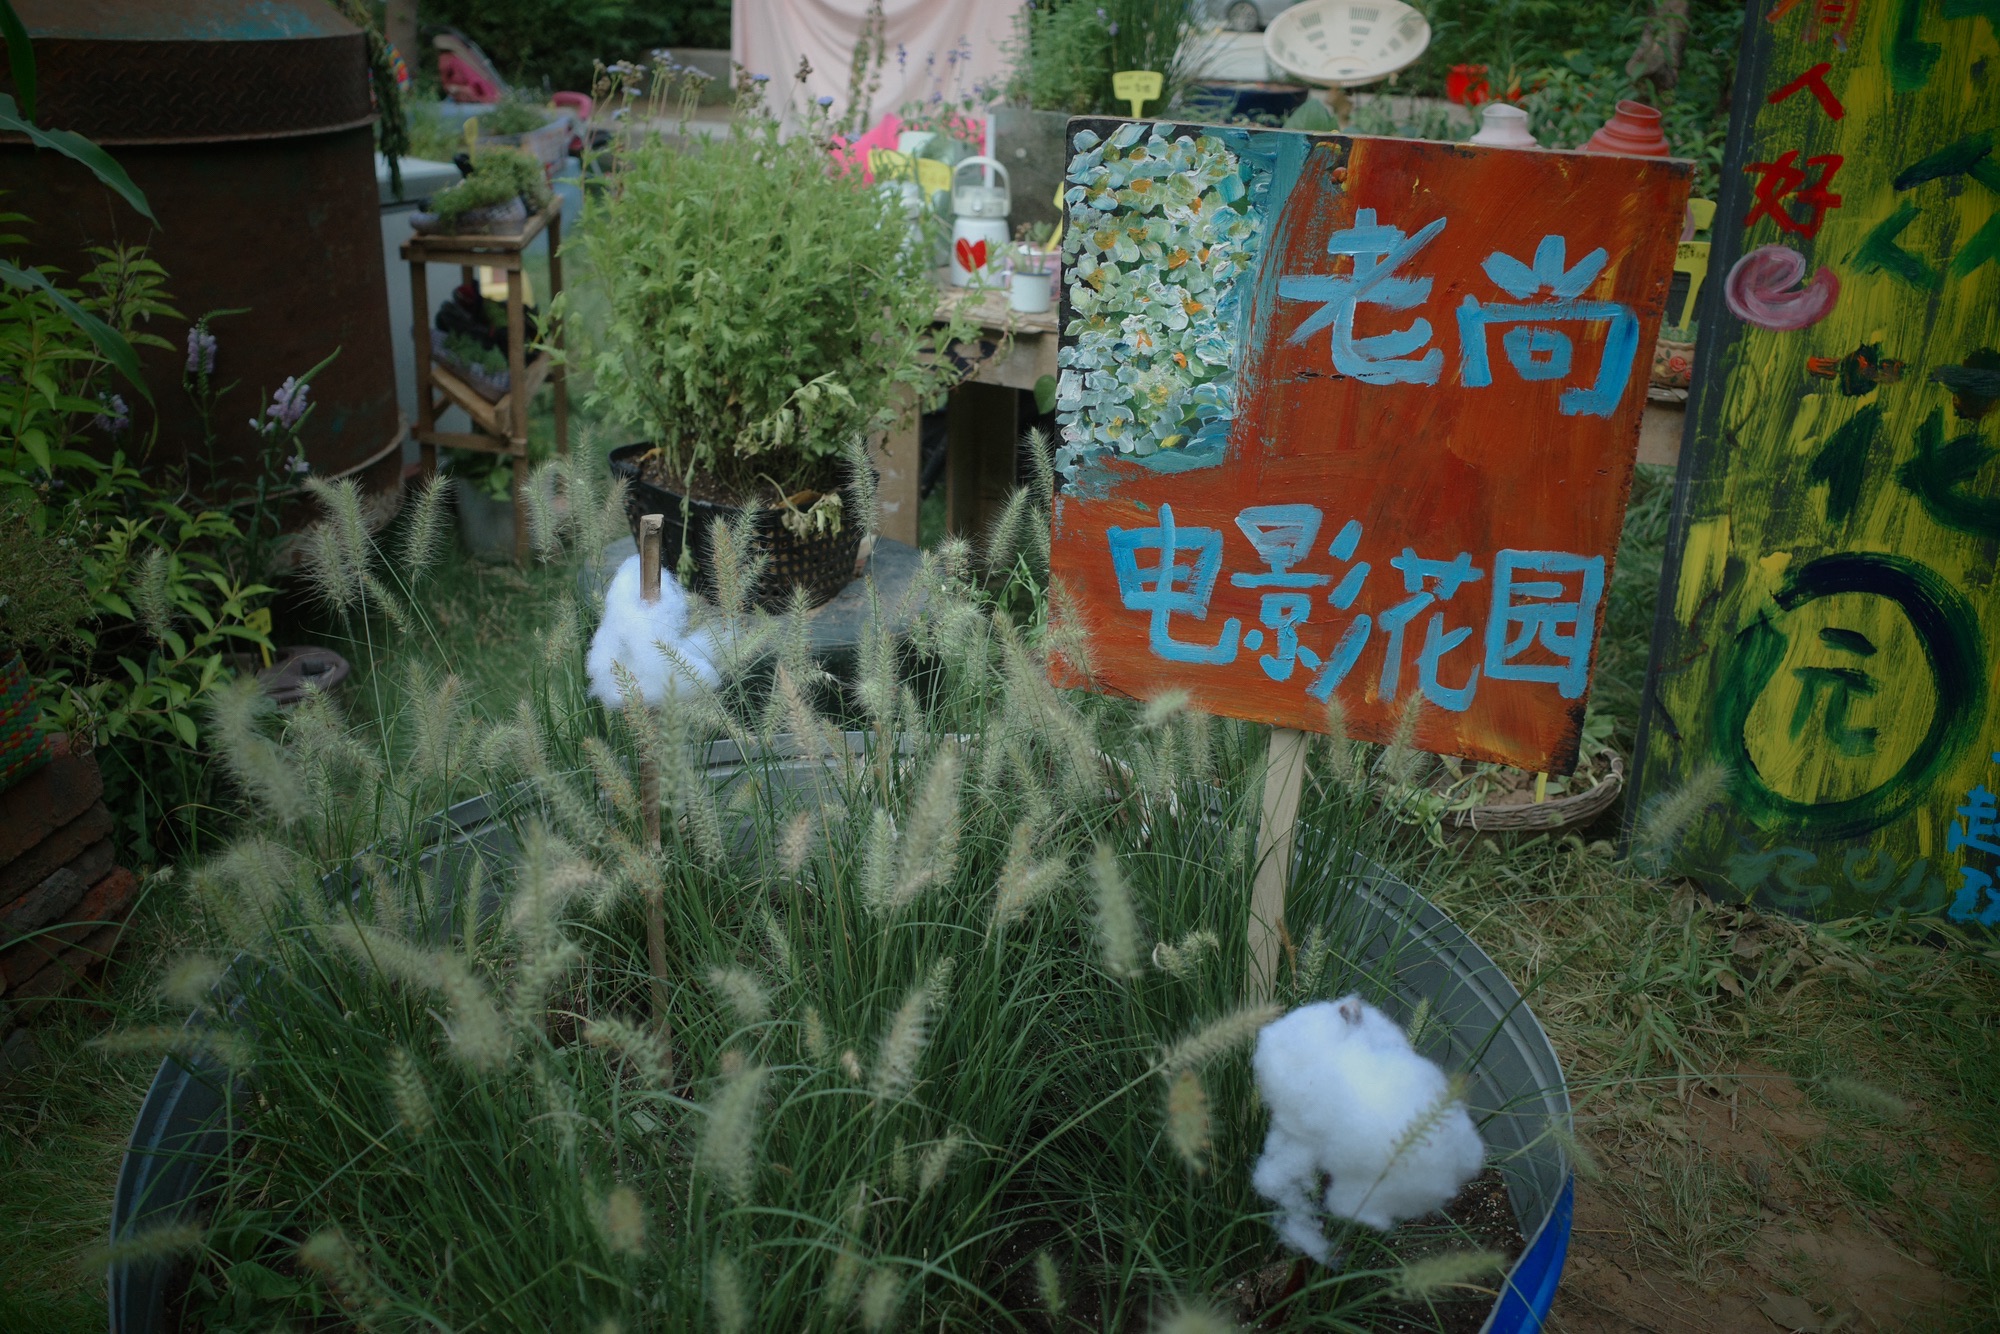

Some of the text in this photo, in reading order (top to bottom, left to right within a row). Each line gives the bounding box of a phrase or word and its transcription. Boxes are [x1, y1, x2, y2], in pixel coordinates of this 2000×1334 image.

[1279, 207, 1639, 417] 老尚
[1106, 503, 1604, 711] 电影花园
